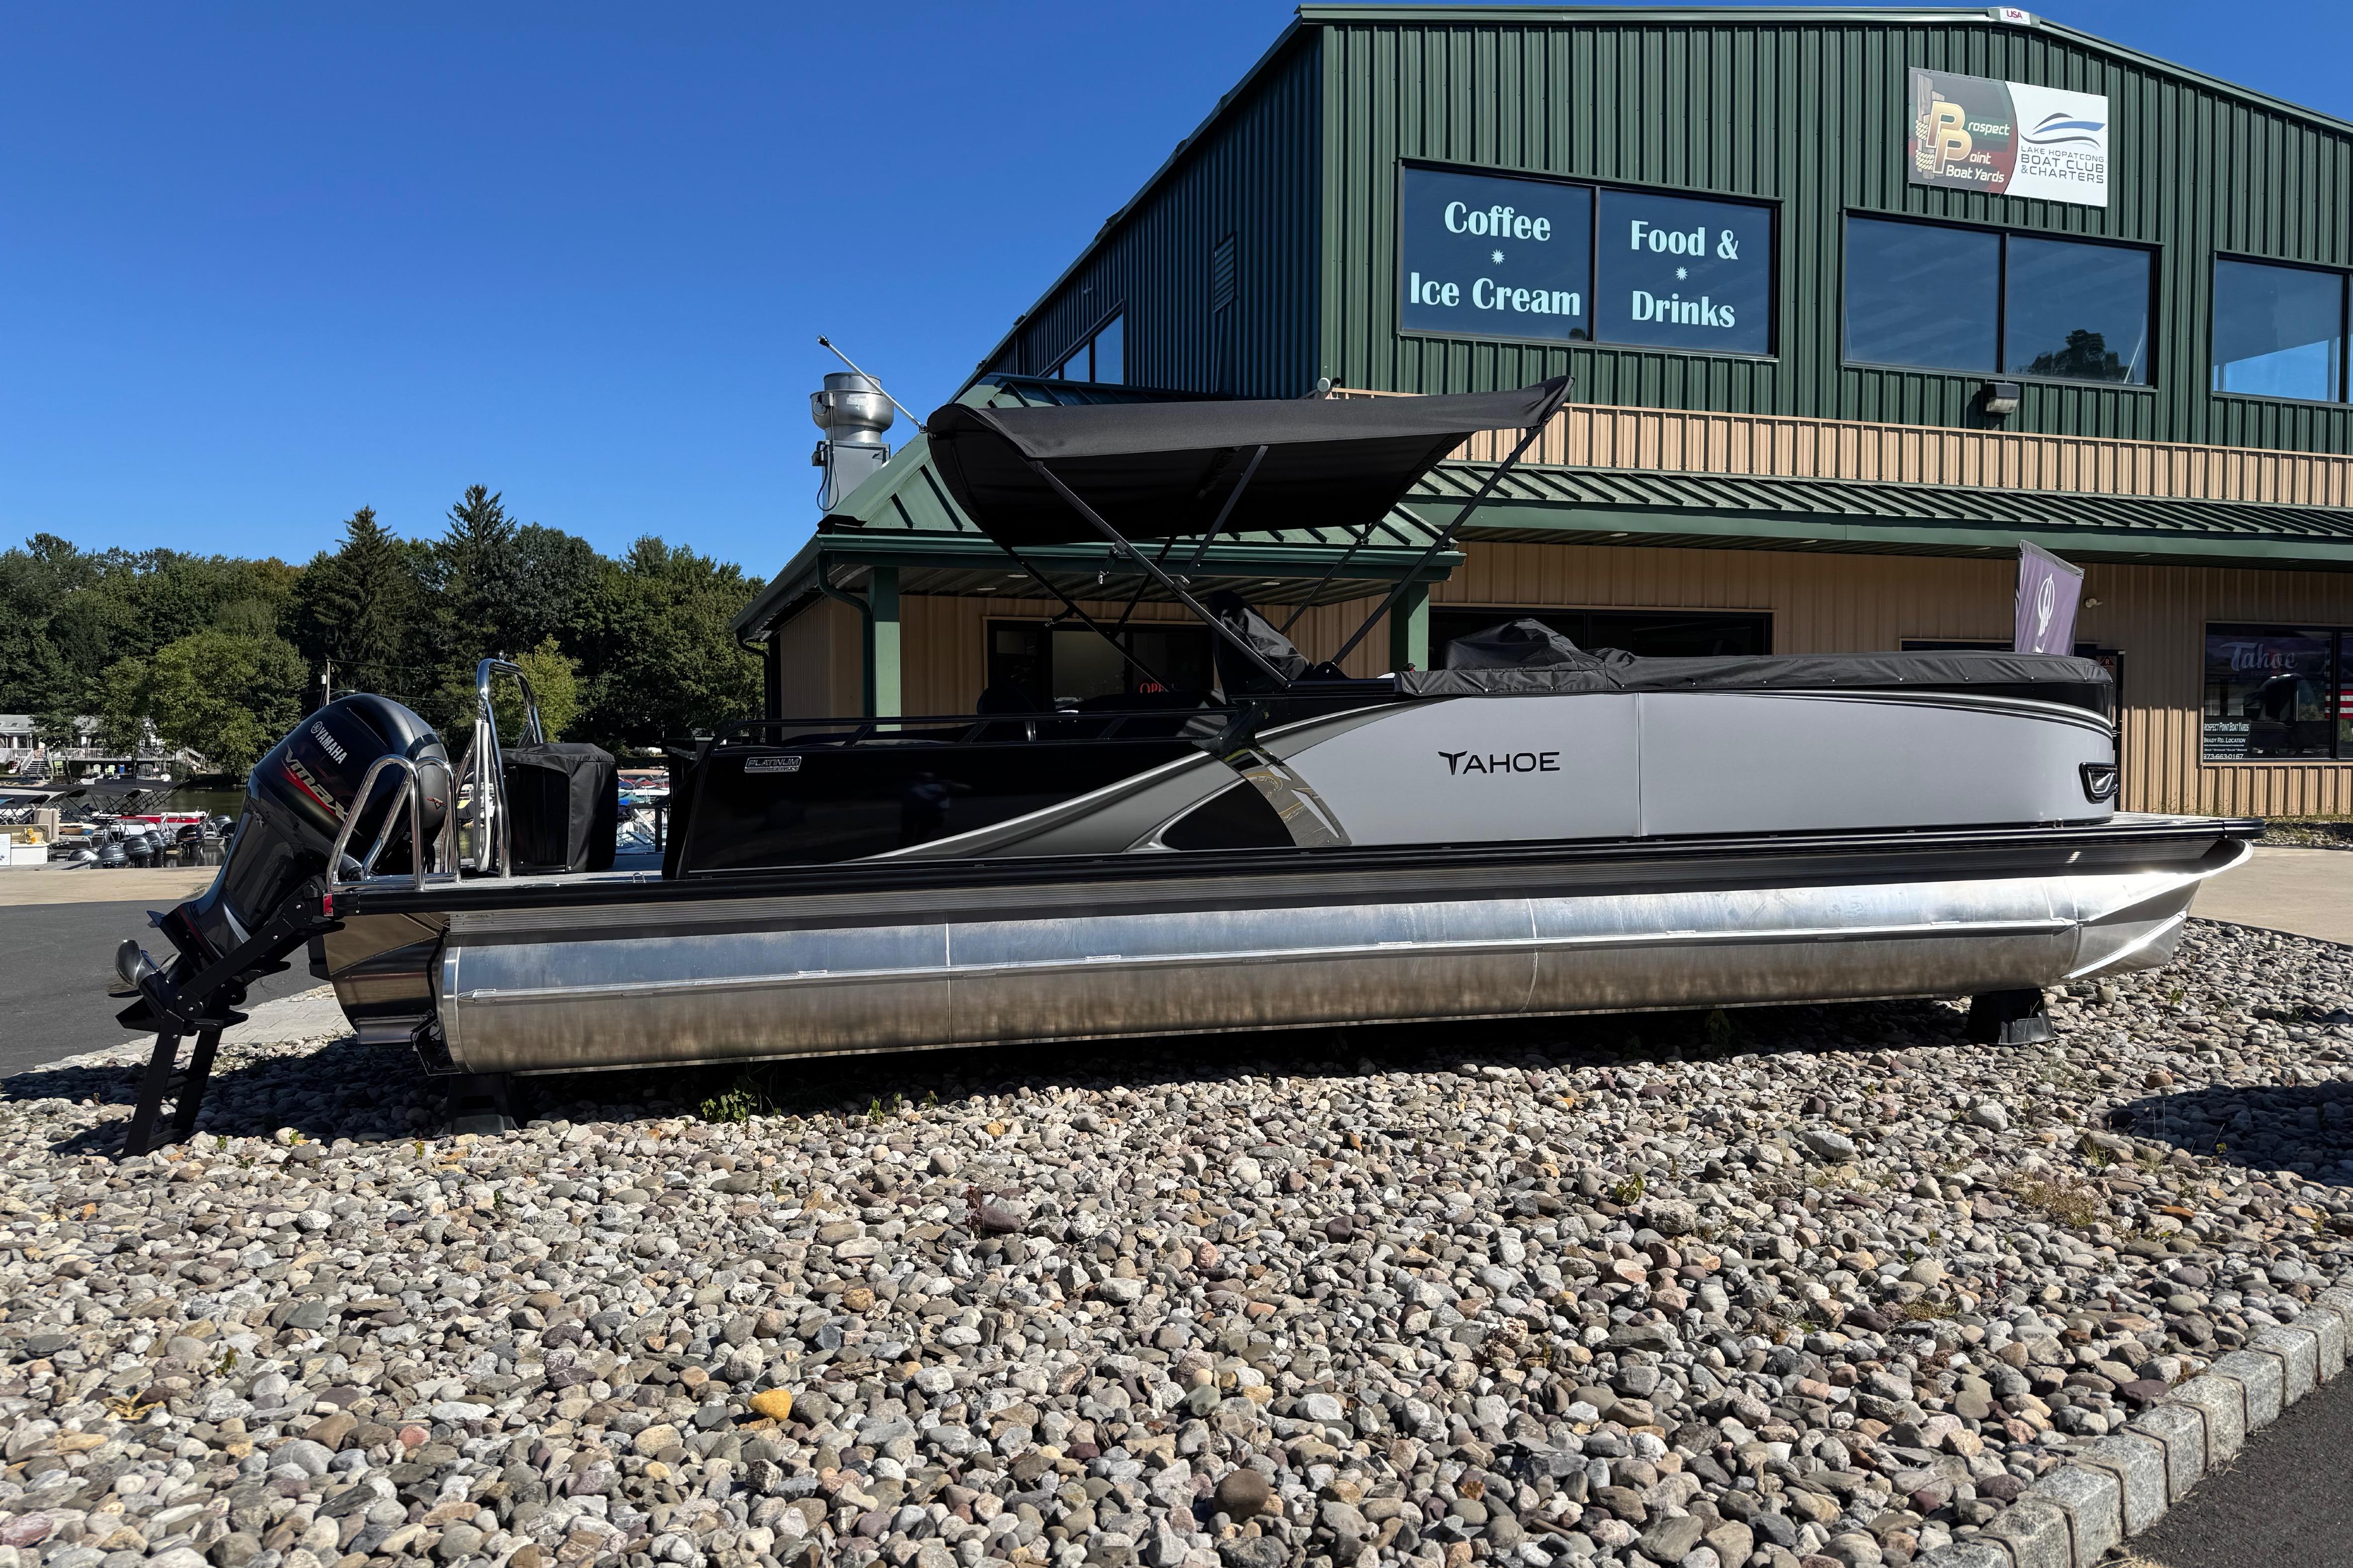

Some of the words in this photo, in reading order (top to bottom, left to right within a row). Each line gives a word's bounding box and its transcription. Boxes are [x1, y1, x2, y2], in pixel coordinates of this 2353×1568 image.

[2006, 9, 2023, 19] USA
[2021, 146, 2045, 155] LAKE
[2048, 149, 2104, 163] HOPATCONG
[2021, 154, 2060, 167] BOAT
[2066, 160, 2104, 173] CLUB
[1945, 164, 1973, 179] Boat
[1974, 168, 2005, 183] Yards
[1444, 201, 1551, 241] Coffee
[1631, 220, 1705, 256] Food
[1717, 229, 1739, 260] &
[1411, 272, 1459, 306] Ice
[1472, 278, 1580, 316] Cream
[1632, 291, 1736, 328] Drinks
[2220, 641, 2298, 672] Tahoe
[315, 726, 347, 764] YAMAHA
[1438, 751, 1560, 775] TAHOE
